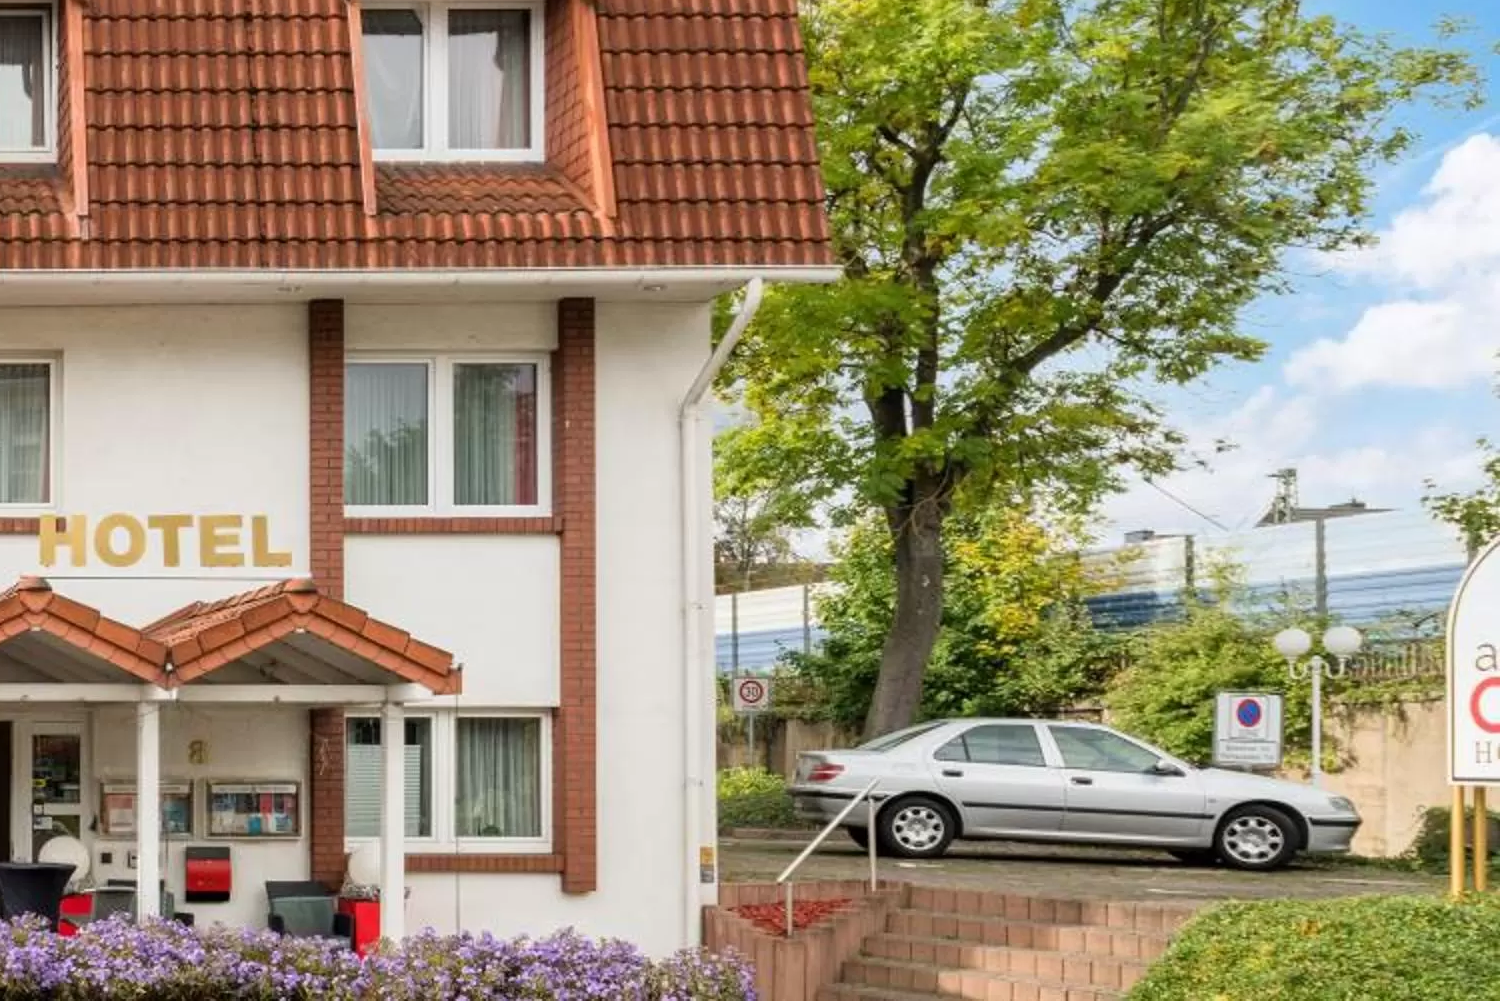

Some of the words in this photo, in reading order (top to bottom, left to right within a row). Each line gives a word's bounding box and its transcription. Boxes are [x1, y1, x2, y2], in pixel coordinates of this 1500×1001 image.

[38, 513, 293, 568] HOTEL
[743, 686, 759, 698] 30
[1475, 741, 1500, 764] H
